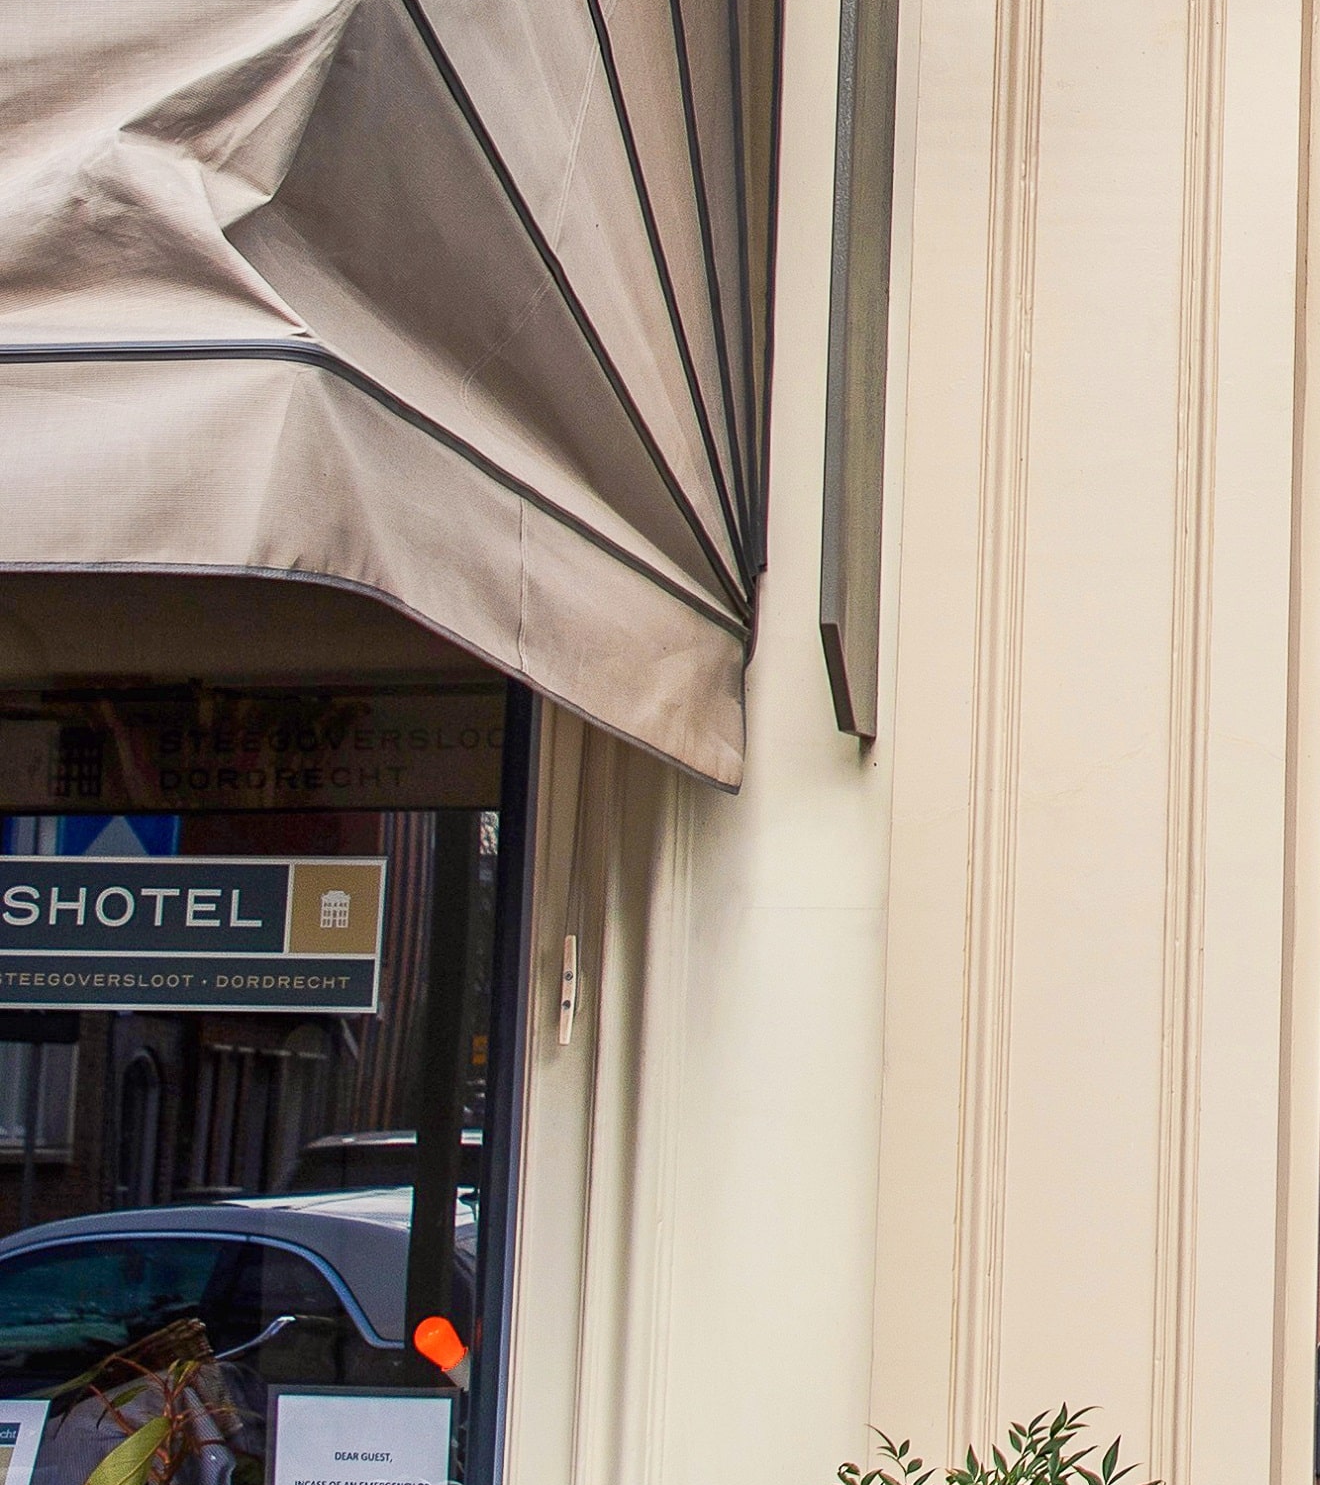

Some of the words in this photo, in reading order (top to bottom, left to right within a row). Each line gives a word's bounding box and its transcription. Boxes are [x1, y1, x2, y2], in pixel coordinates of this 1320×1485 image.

[2, 885, 263, 928] SHOTEL
[0, 972, 194, 988] TEEGOVERSLOOT
[216, 974, 351, 990] DORDRECHT
[334, 1451, 359, 1461] DEAR
[361, 1452, 393, 1463] GUEST,
